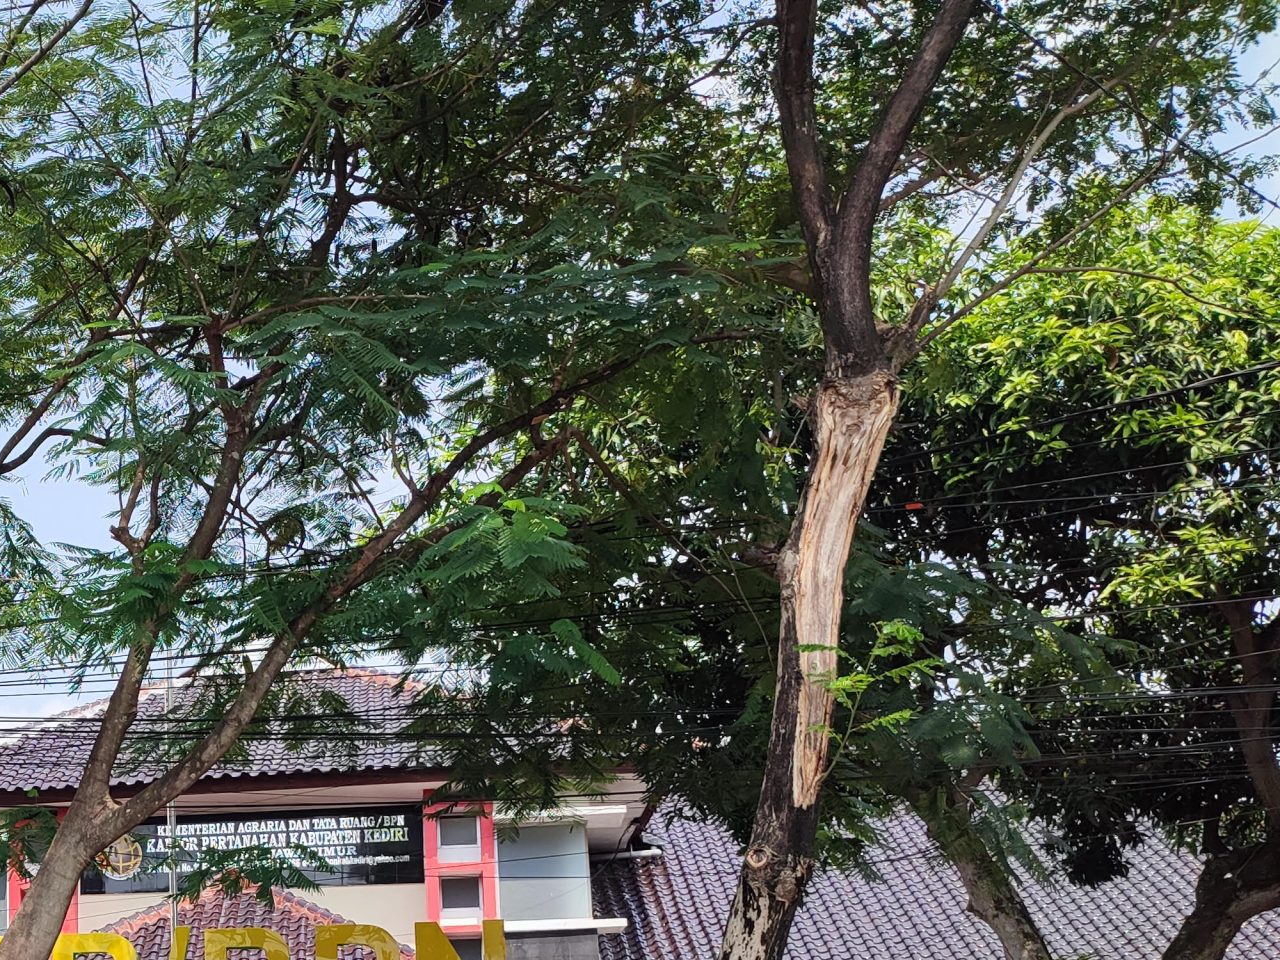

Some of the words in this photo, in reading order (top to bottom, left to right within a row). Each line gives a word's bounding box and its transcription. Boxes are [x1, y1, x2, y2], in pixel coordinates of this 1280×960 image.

[237, 820, 286, 833] AGRARIA
[288, 819, 310, 831] DAN
[312, 818, 338, 830] TATA
[200, 833, 287, 851] PERTANAHAN
[289, 830, 362, 846] KABUPATEN
[364, 827, 409, 843] KEDIRI
